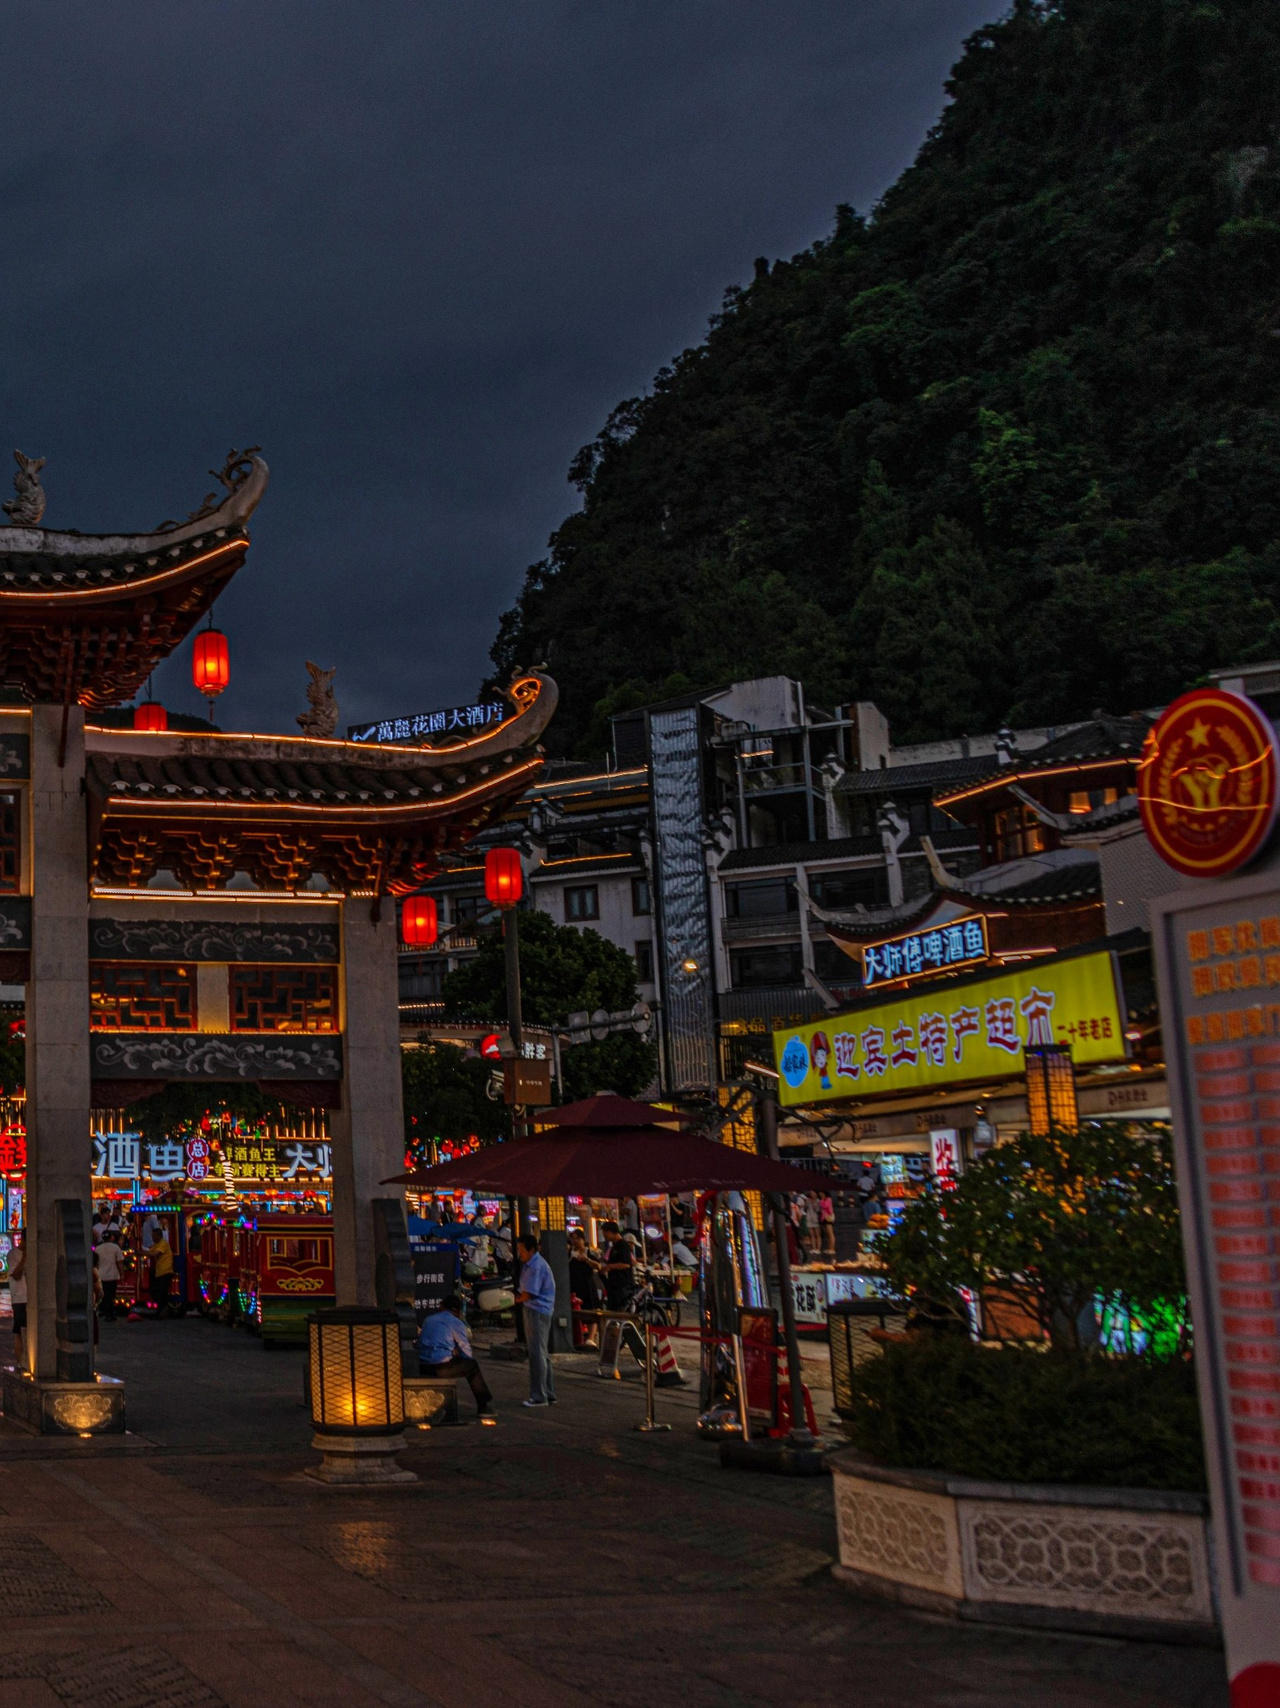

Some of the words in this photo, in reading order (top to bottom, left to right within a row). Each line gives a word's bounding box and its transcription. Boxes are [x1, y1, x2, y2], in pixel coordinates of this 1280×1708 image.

[377, 702, 504, 742] 萬麗花園大酒店
[865, 920, 985, 985] 大师傅啤酒鱼
[833, 986, 1055, 1080] 迎宾土特产超市
